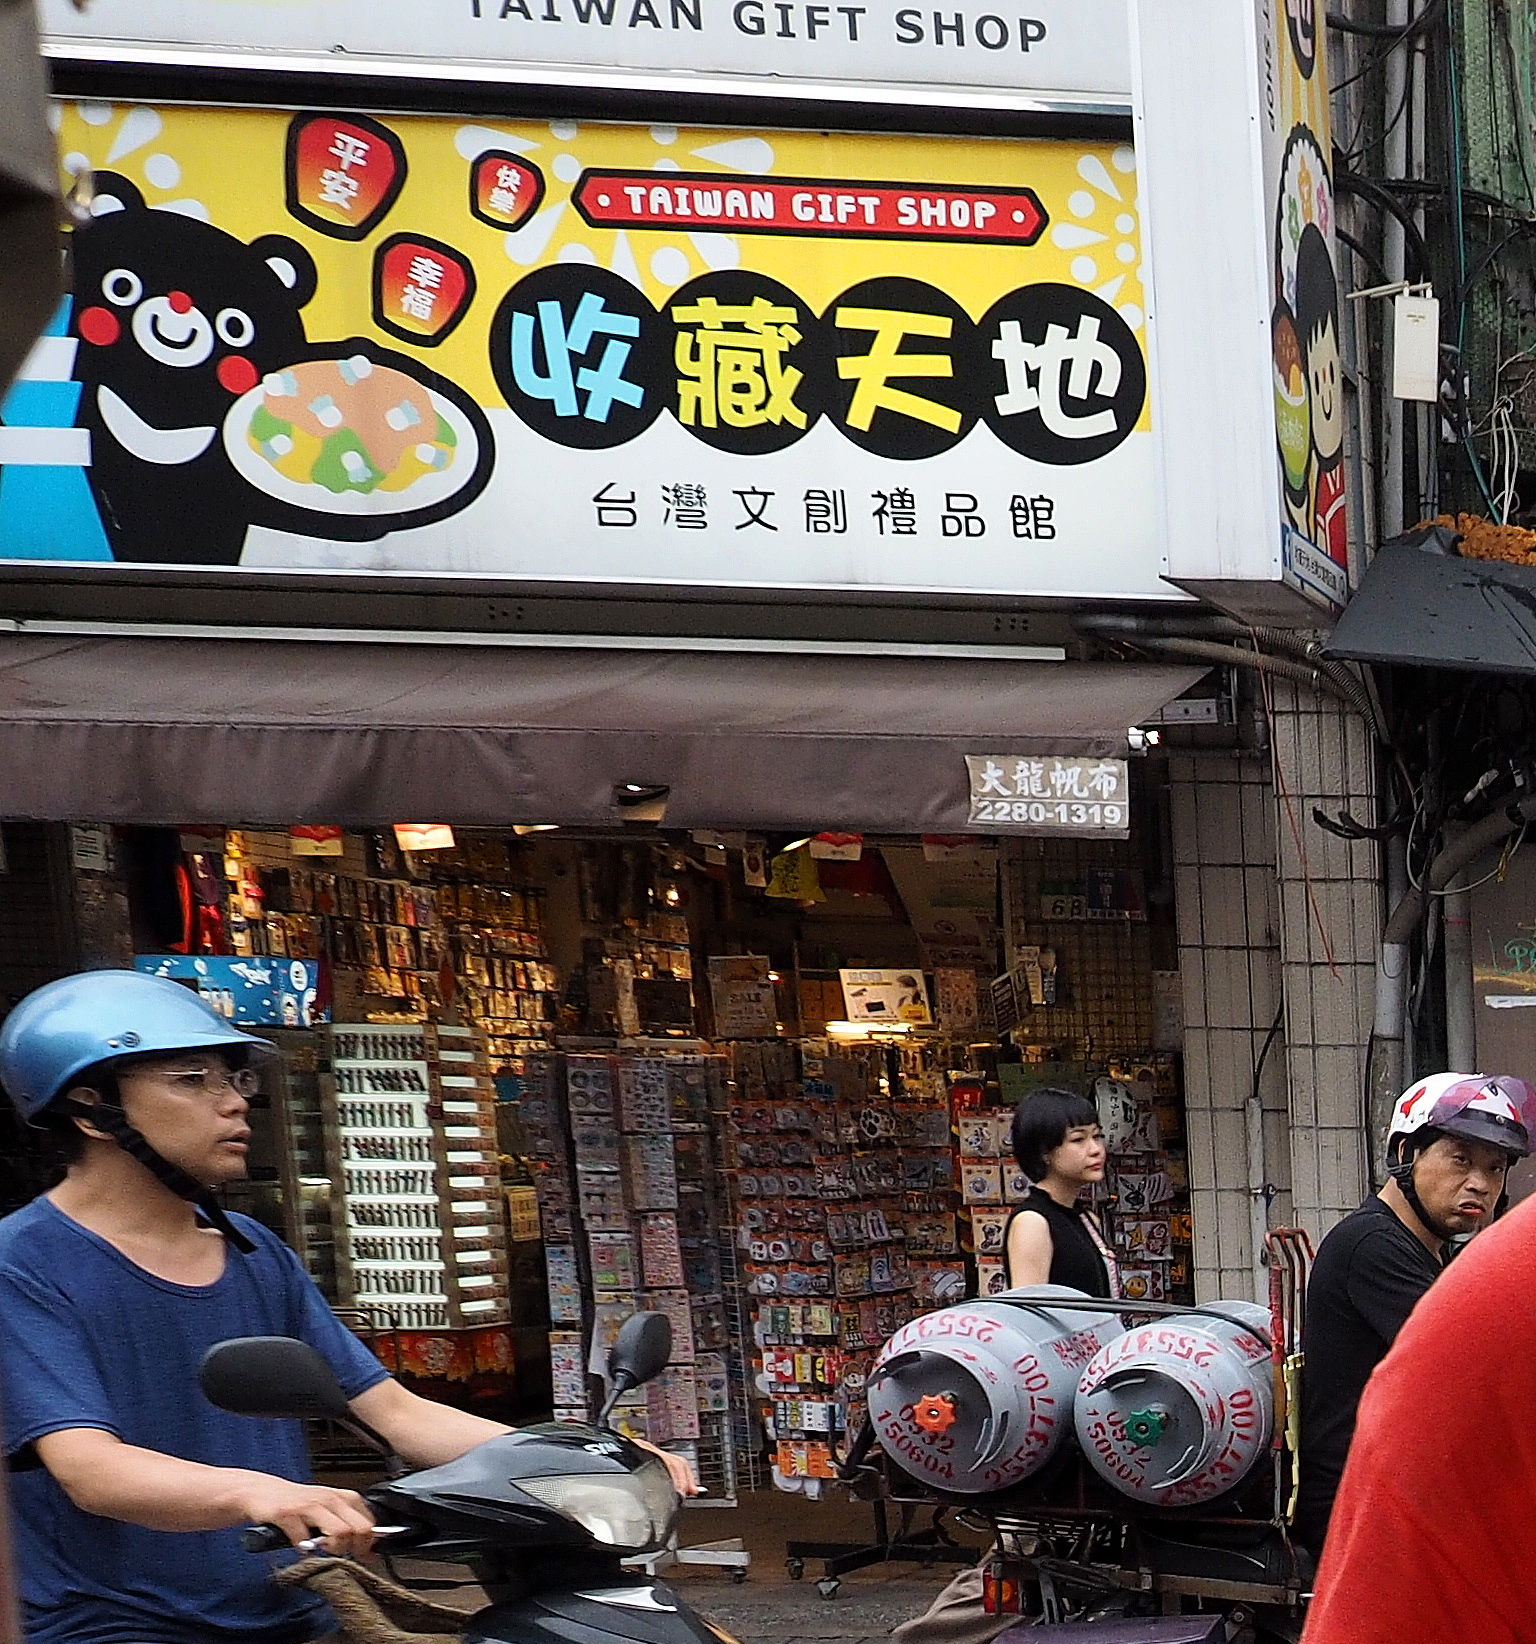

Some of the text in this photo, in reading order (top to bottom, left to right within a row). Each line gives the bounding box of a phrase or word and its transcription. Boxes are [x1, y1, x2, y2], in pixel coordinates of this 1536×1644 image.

[733, 0, 867, 43] GIFT
[895, 8, 1048, 53] SHOP
[317, 130, 372, 211] 平安
[487, 165, 522, 214] 快樂
[624, 186, 997, 230] TAIWAN GIFT SHOP
[400, 254, 445, 322] 幸福
[511, 293, 1124, 440] 收藏天地
[592, 481, 1057, 541] 台灣文創禮品館
[978, 760, 1119, 800] 大龍帆布
[976, 800, 1121, 824] 2280-1319
